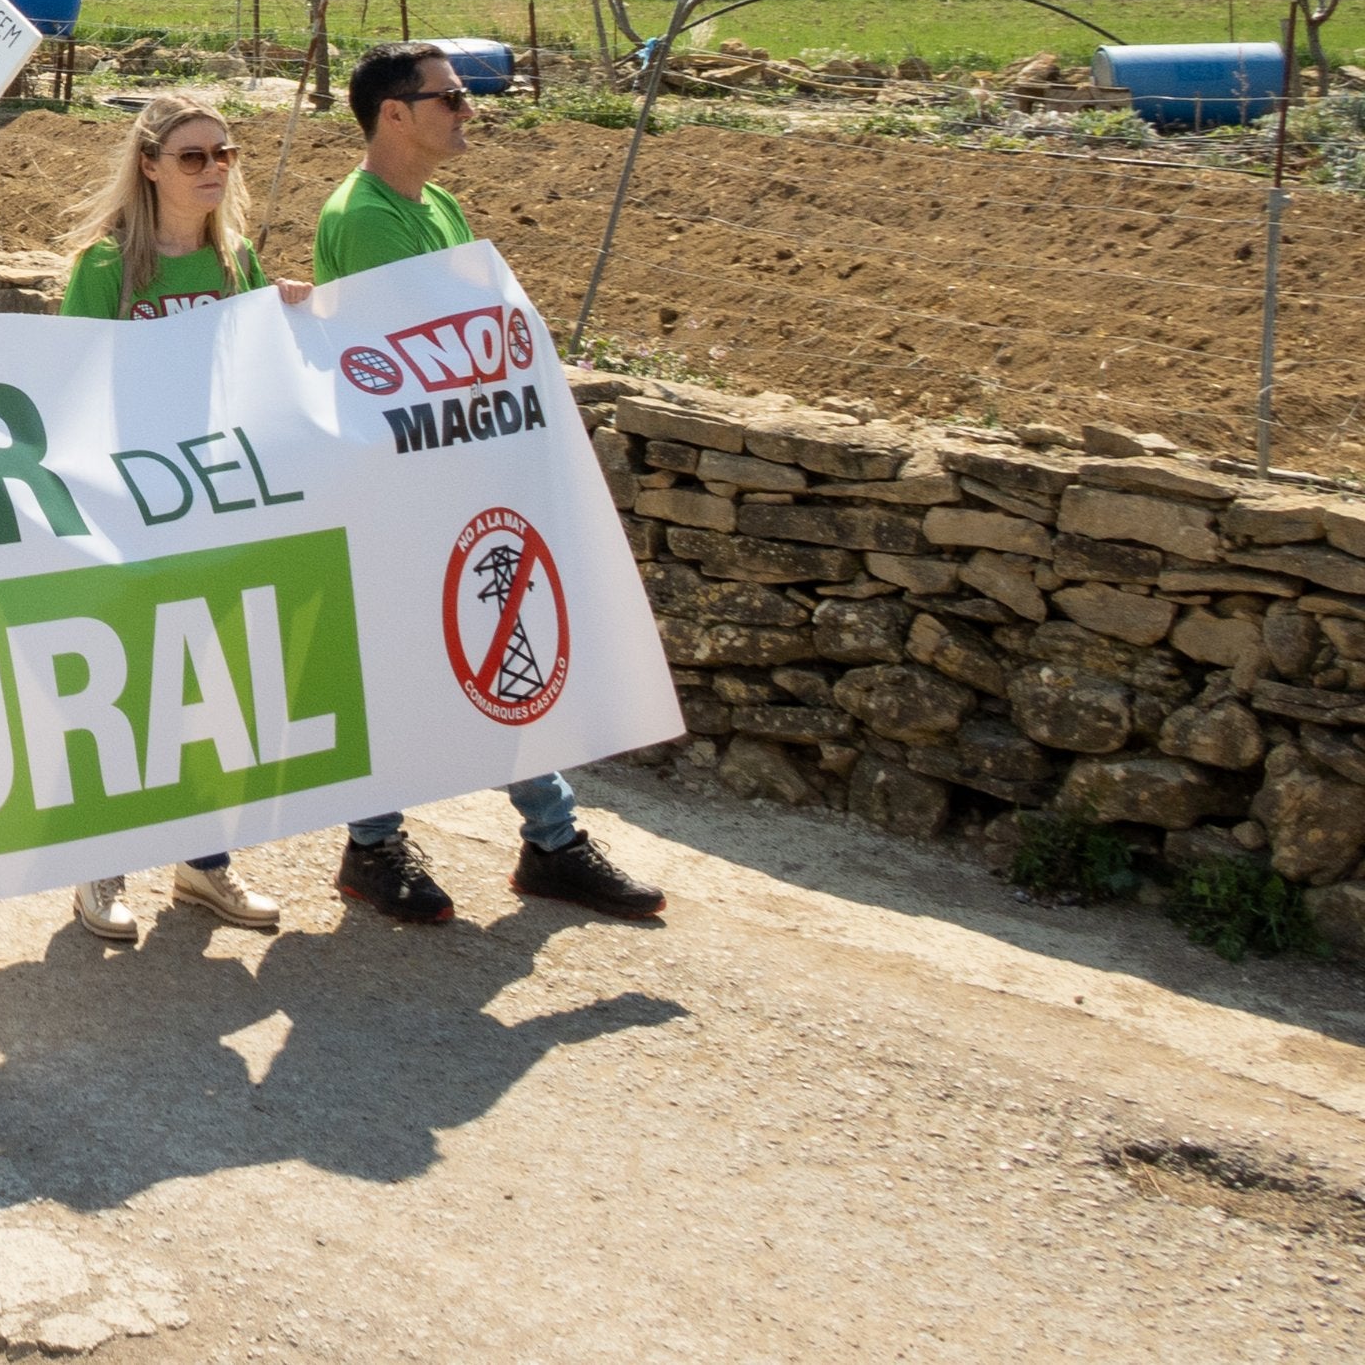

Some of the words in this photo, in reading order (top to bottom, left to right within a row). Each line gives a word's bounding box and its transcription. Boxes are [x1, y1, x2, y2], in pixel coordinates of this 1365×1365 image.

[397, 315, 503, 383] NO
[382, 385, 546, 454] MAGDA
[110, 426, 306, 527] DEL
[457, 526, 475, 553] NO
[476, 518, 486, 534] A
[486, 512, 503, 529] LA
[503, 512, 528, 535] MAT
[464, 679, 528, 720] COMARQUES
